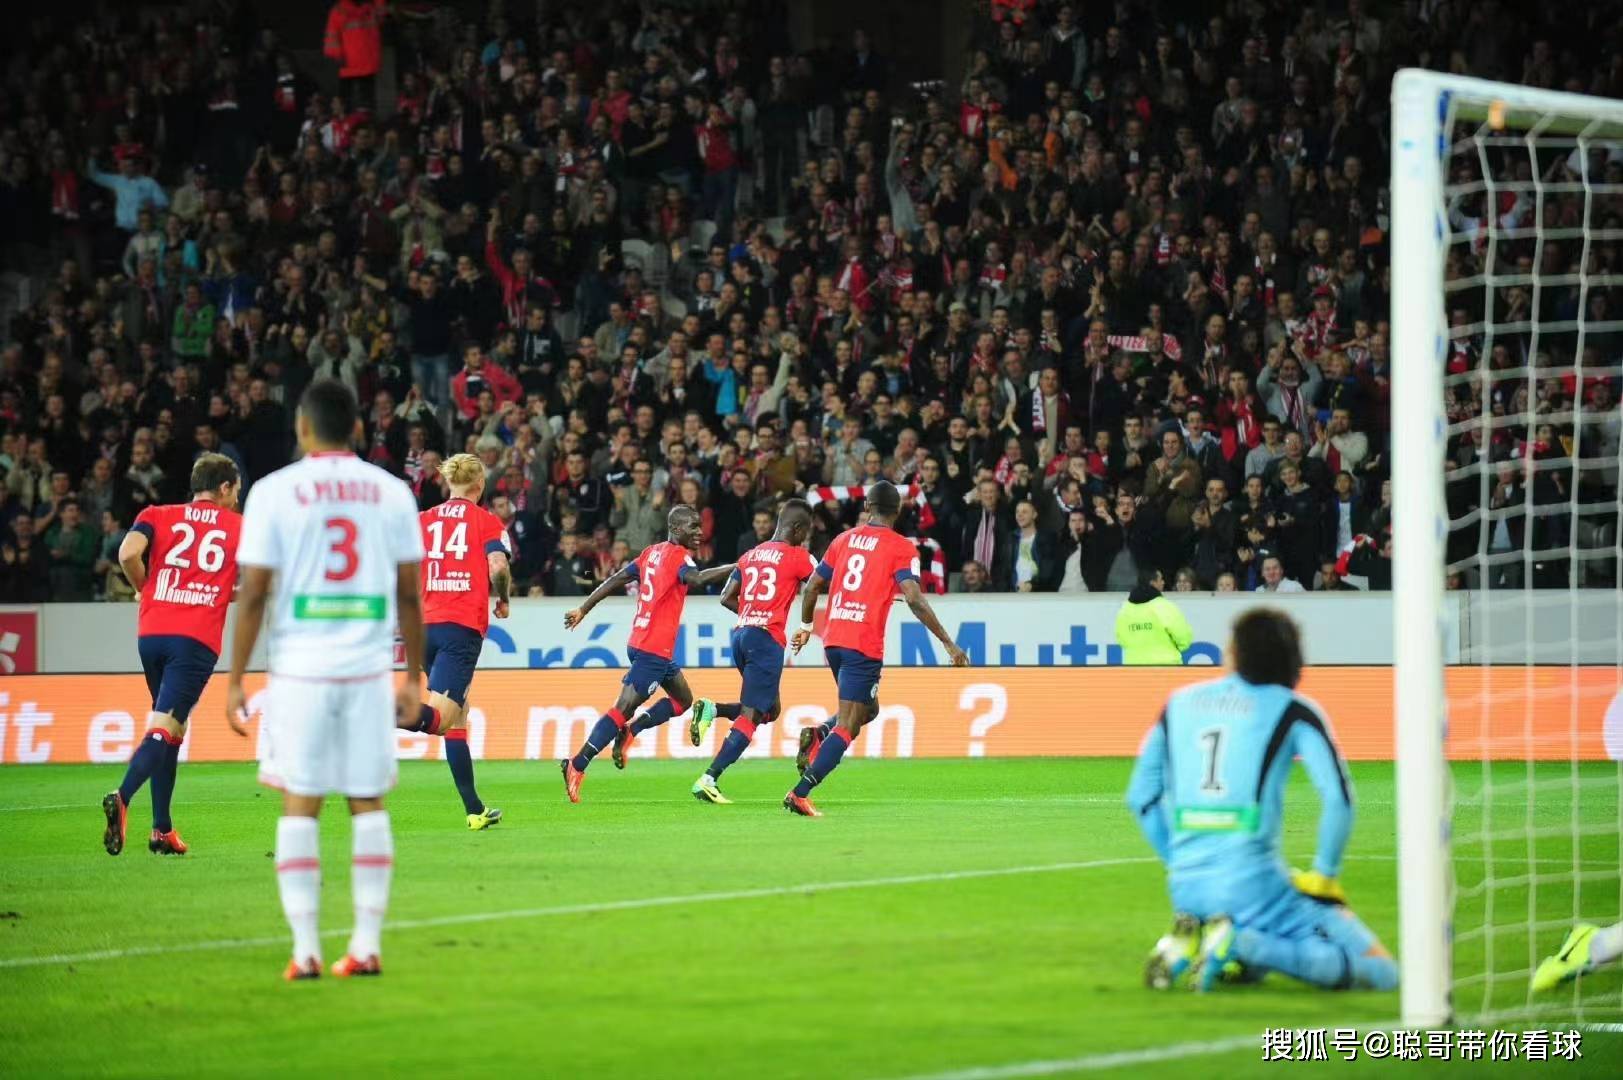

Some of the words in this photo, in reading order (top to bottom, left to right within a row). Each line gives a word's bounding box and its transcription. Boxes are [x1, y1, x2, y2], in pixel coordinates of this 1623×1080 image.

[184, 506, 219, 525] ROUX
[164, 522, 227, 573] 26
[324, 516, 360, 582] 3
[427, 520, 468, 560] 14
[640, 567, 656, 602] 5
[743, 566, 777, 601] 23
[842, 553, 866, 592] 8
[87, 710, 191, 763] e
[1198, 726, 1225, 794] 1
